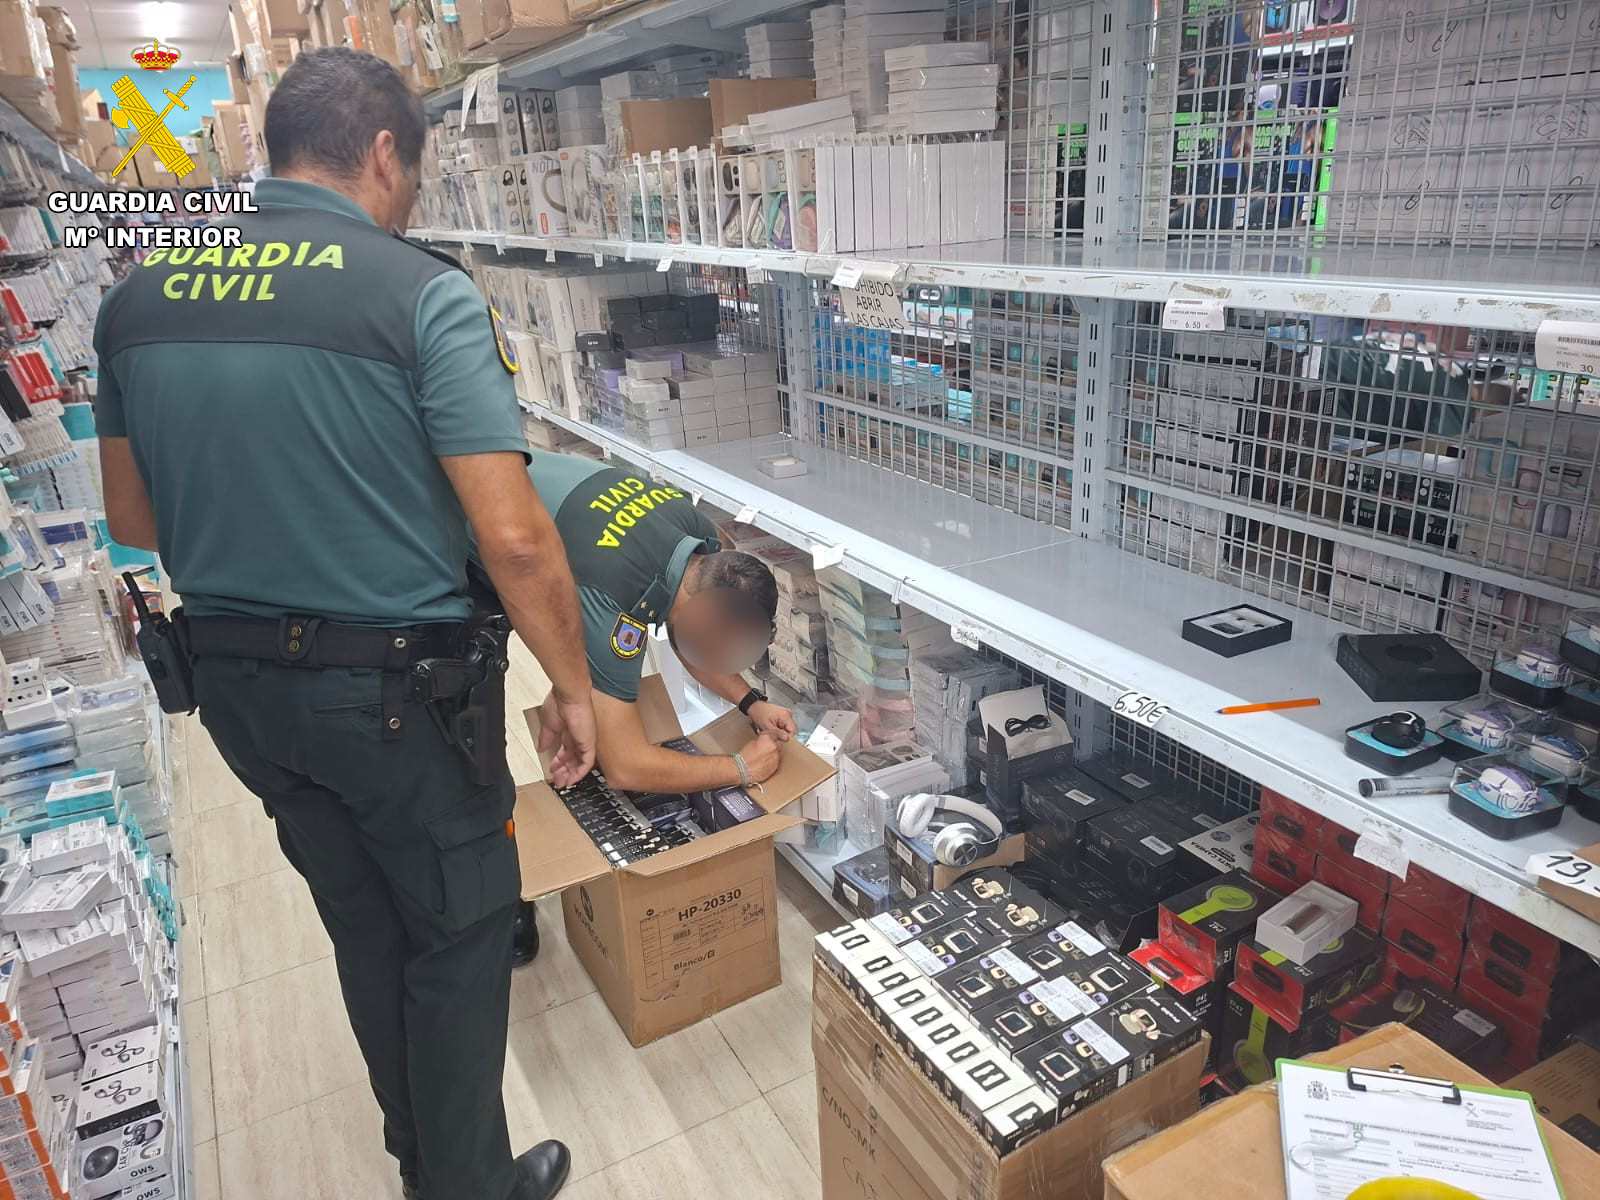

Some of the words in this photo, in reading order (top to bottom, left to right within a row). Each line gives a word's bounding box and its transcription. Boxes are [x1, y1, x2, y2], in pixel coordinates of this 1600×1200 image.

[143, 241, 345, 271] GUARDIA
[163, 272, 277, 302] CIVIL
[856, 296, 884, 313] ABRIR
[850, 312, 870, 327] LAS
[870, 315, 905, 330] CAJAS
[1579, 364, 1594, 374] 30
[589, 477, 645, 513] CIVIL
[597, 487, 684, 549] GUARDIA
[1114, 691, 1165, 724] 6,50€
[678, 888, 742, 922] HP-20330
[130, 1164, 155, 1178] OWS
[136, 1186, 161, 1200] OWS
